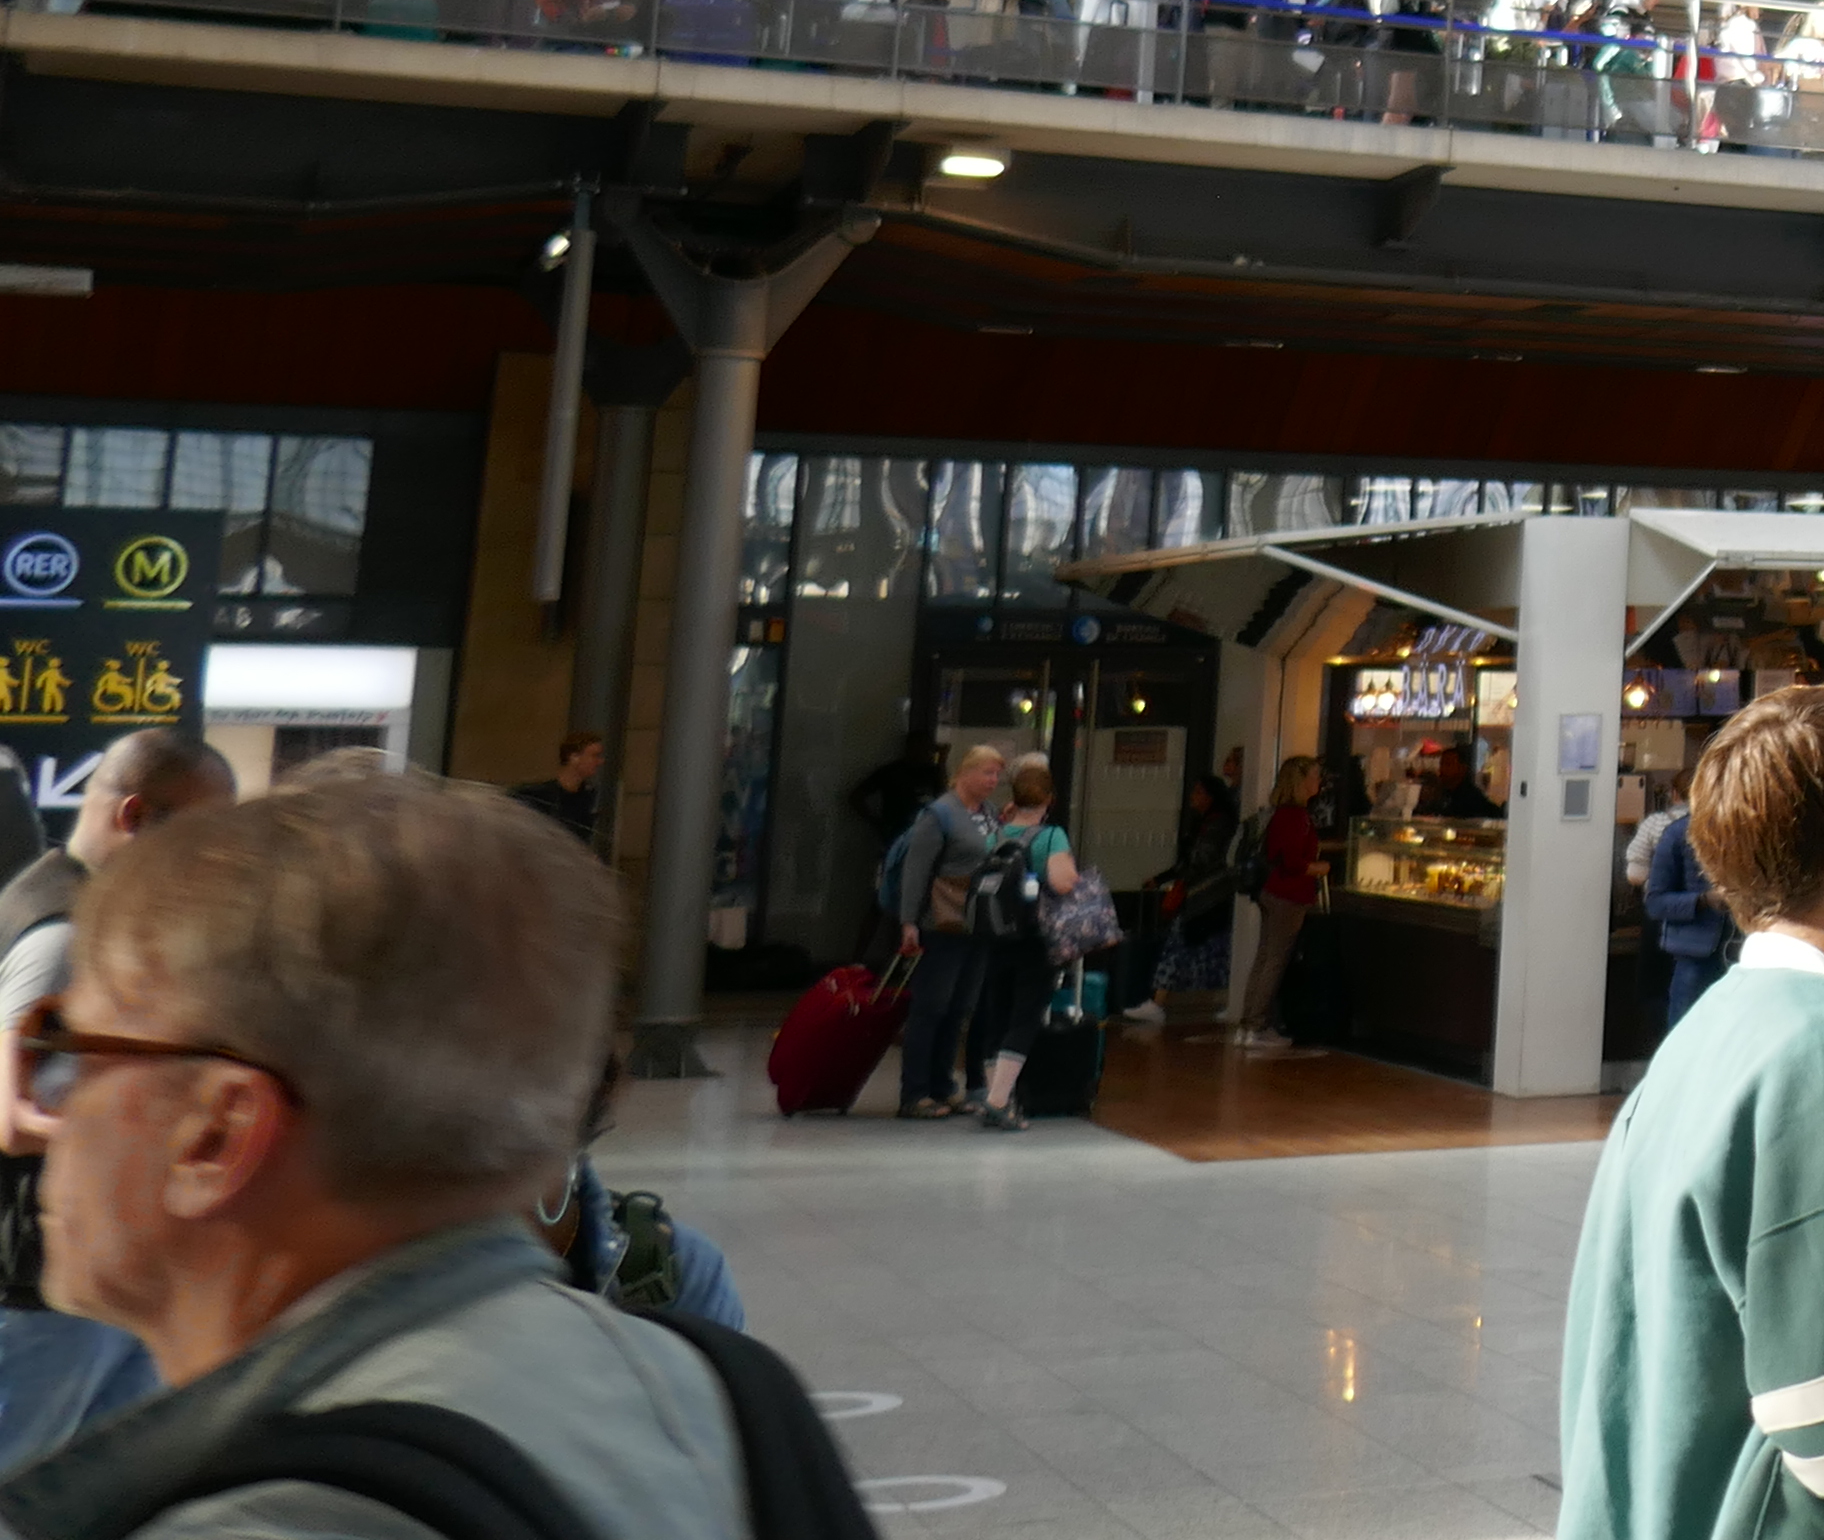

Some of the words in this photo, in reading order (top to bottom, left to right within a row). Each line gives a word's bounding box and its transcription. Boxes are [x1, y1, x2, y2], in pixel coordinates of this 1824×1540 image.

[15, 552, 71, 578] RER
[131, 549, 173, 584] M
[14, 639, 51, 656] WC
[125, 641, 162, 657] WC
